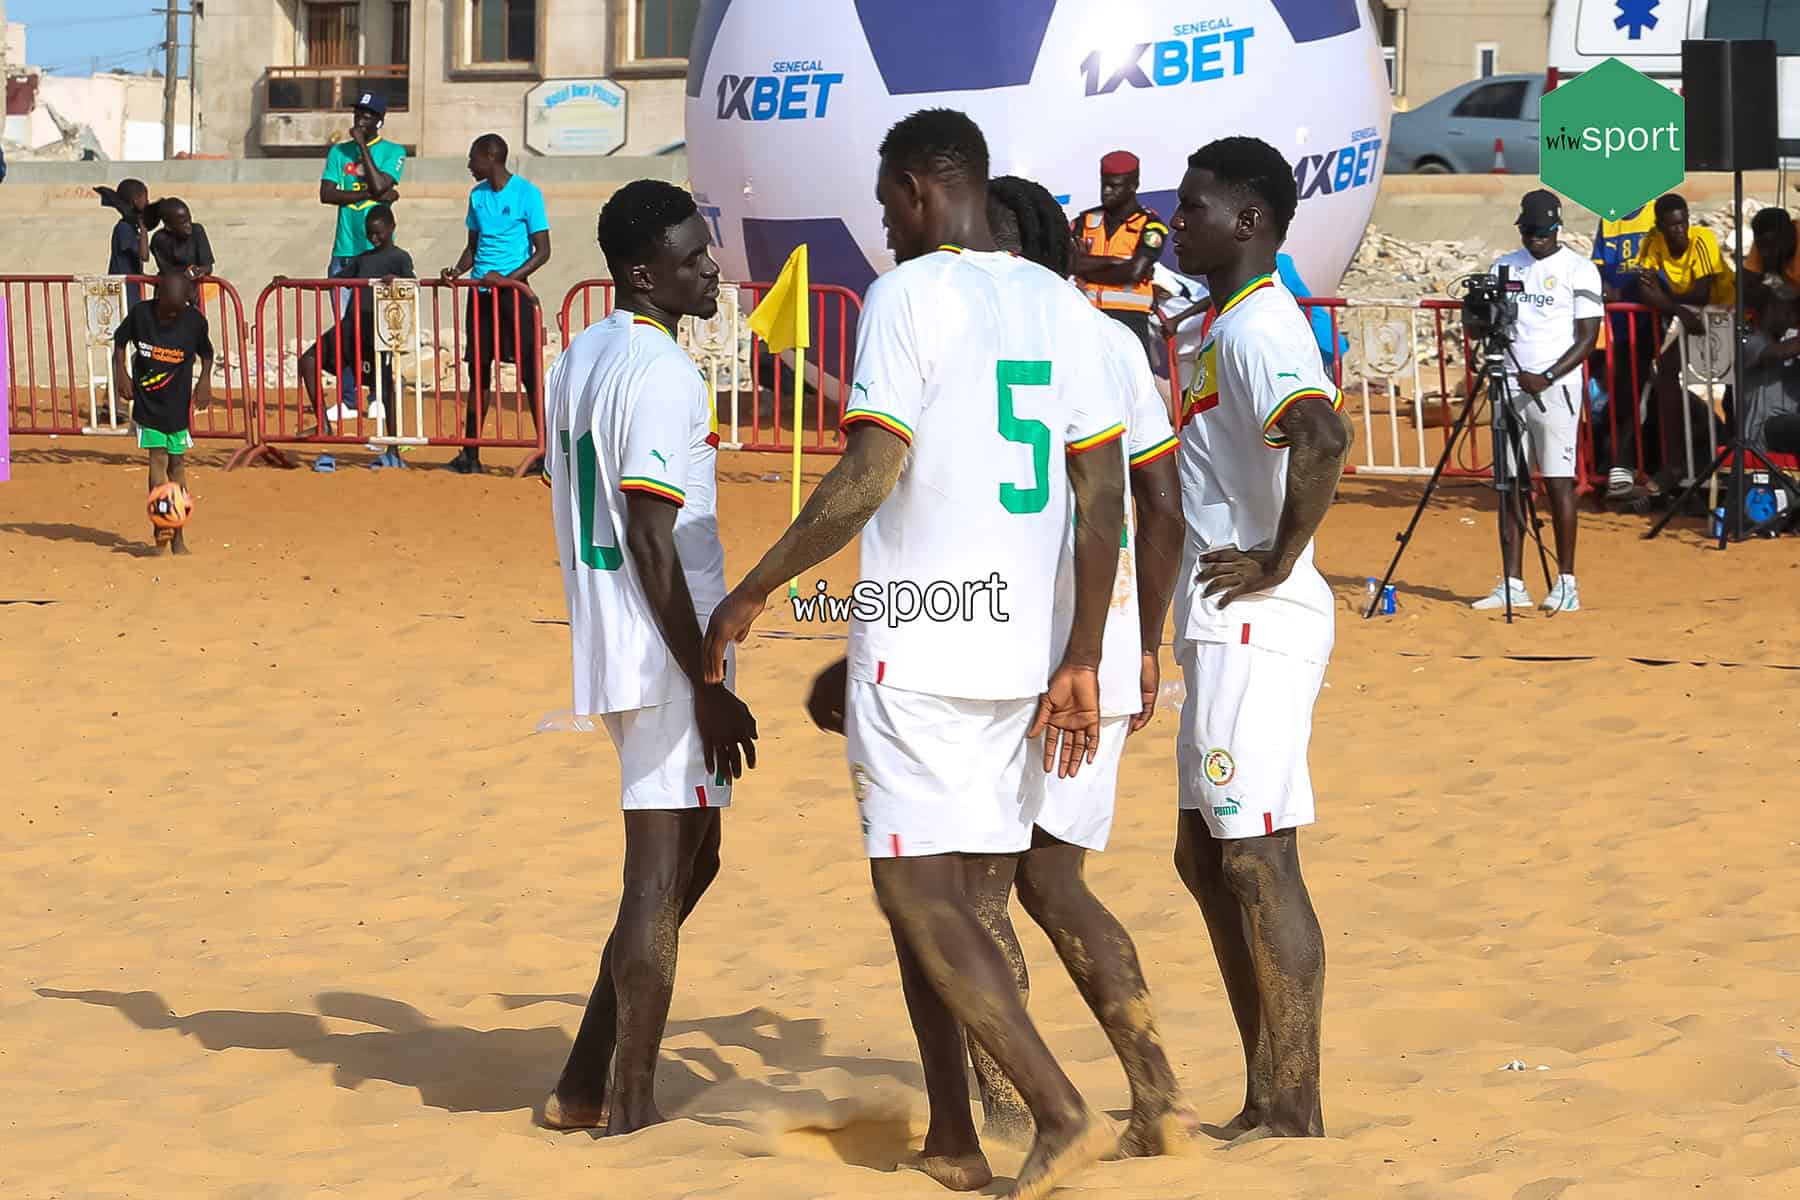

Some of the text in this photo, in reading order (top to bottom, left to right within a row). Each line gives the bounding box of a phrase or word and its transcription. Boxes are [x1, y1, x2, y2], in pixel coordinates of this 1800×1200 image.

[1173, 16, 1233, 36] SENEGAL
[771, 60, 824, 73] SENEGAL
[1080, 26, 1255, 97] 1XBET
[716, 73, 844, 120] 1XBET
[1294, 139, 1382, 200] 1XBET
[1508, 291, 1554, 308] range
[996, 359, 1052, 514] 5
